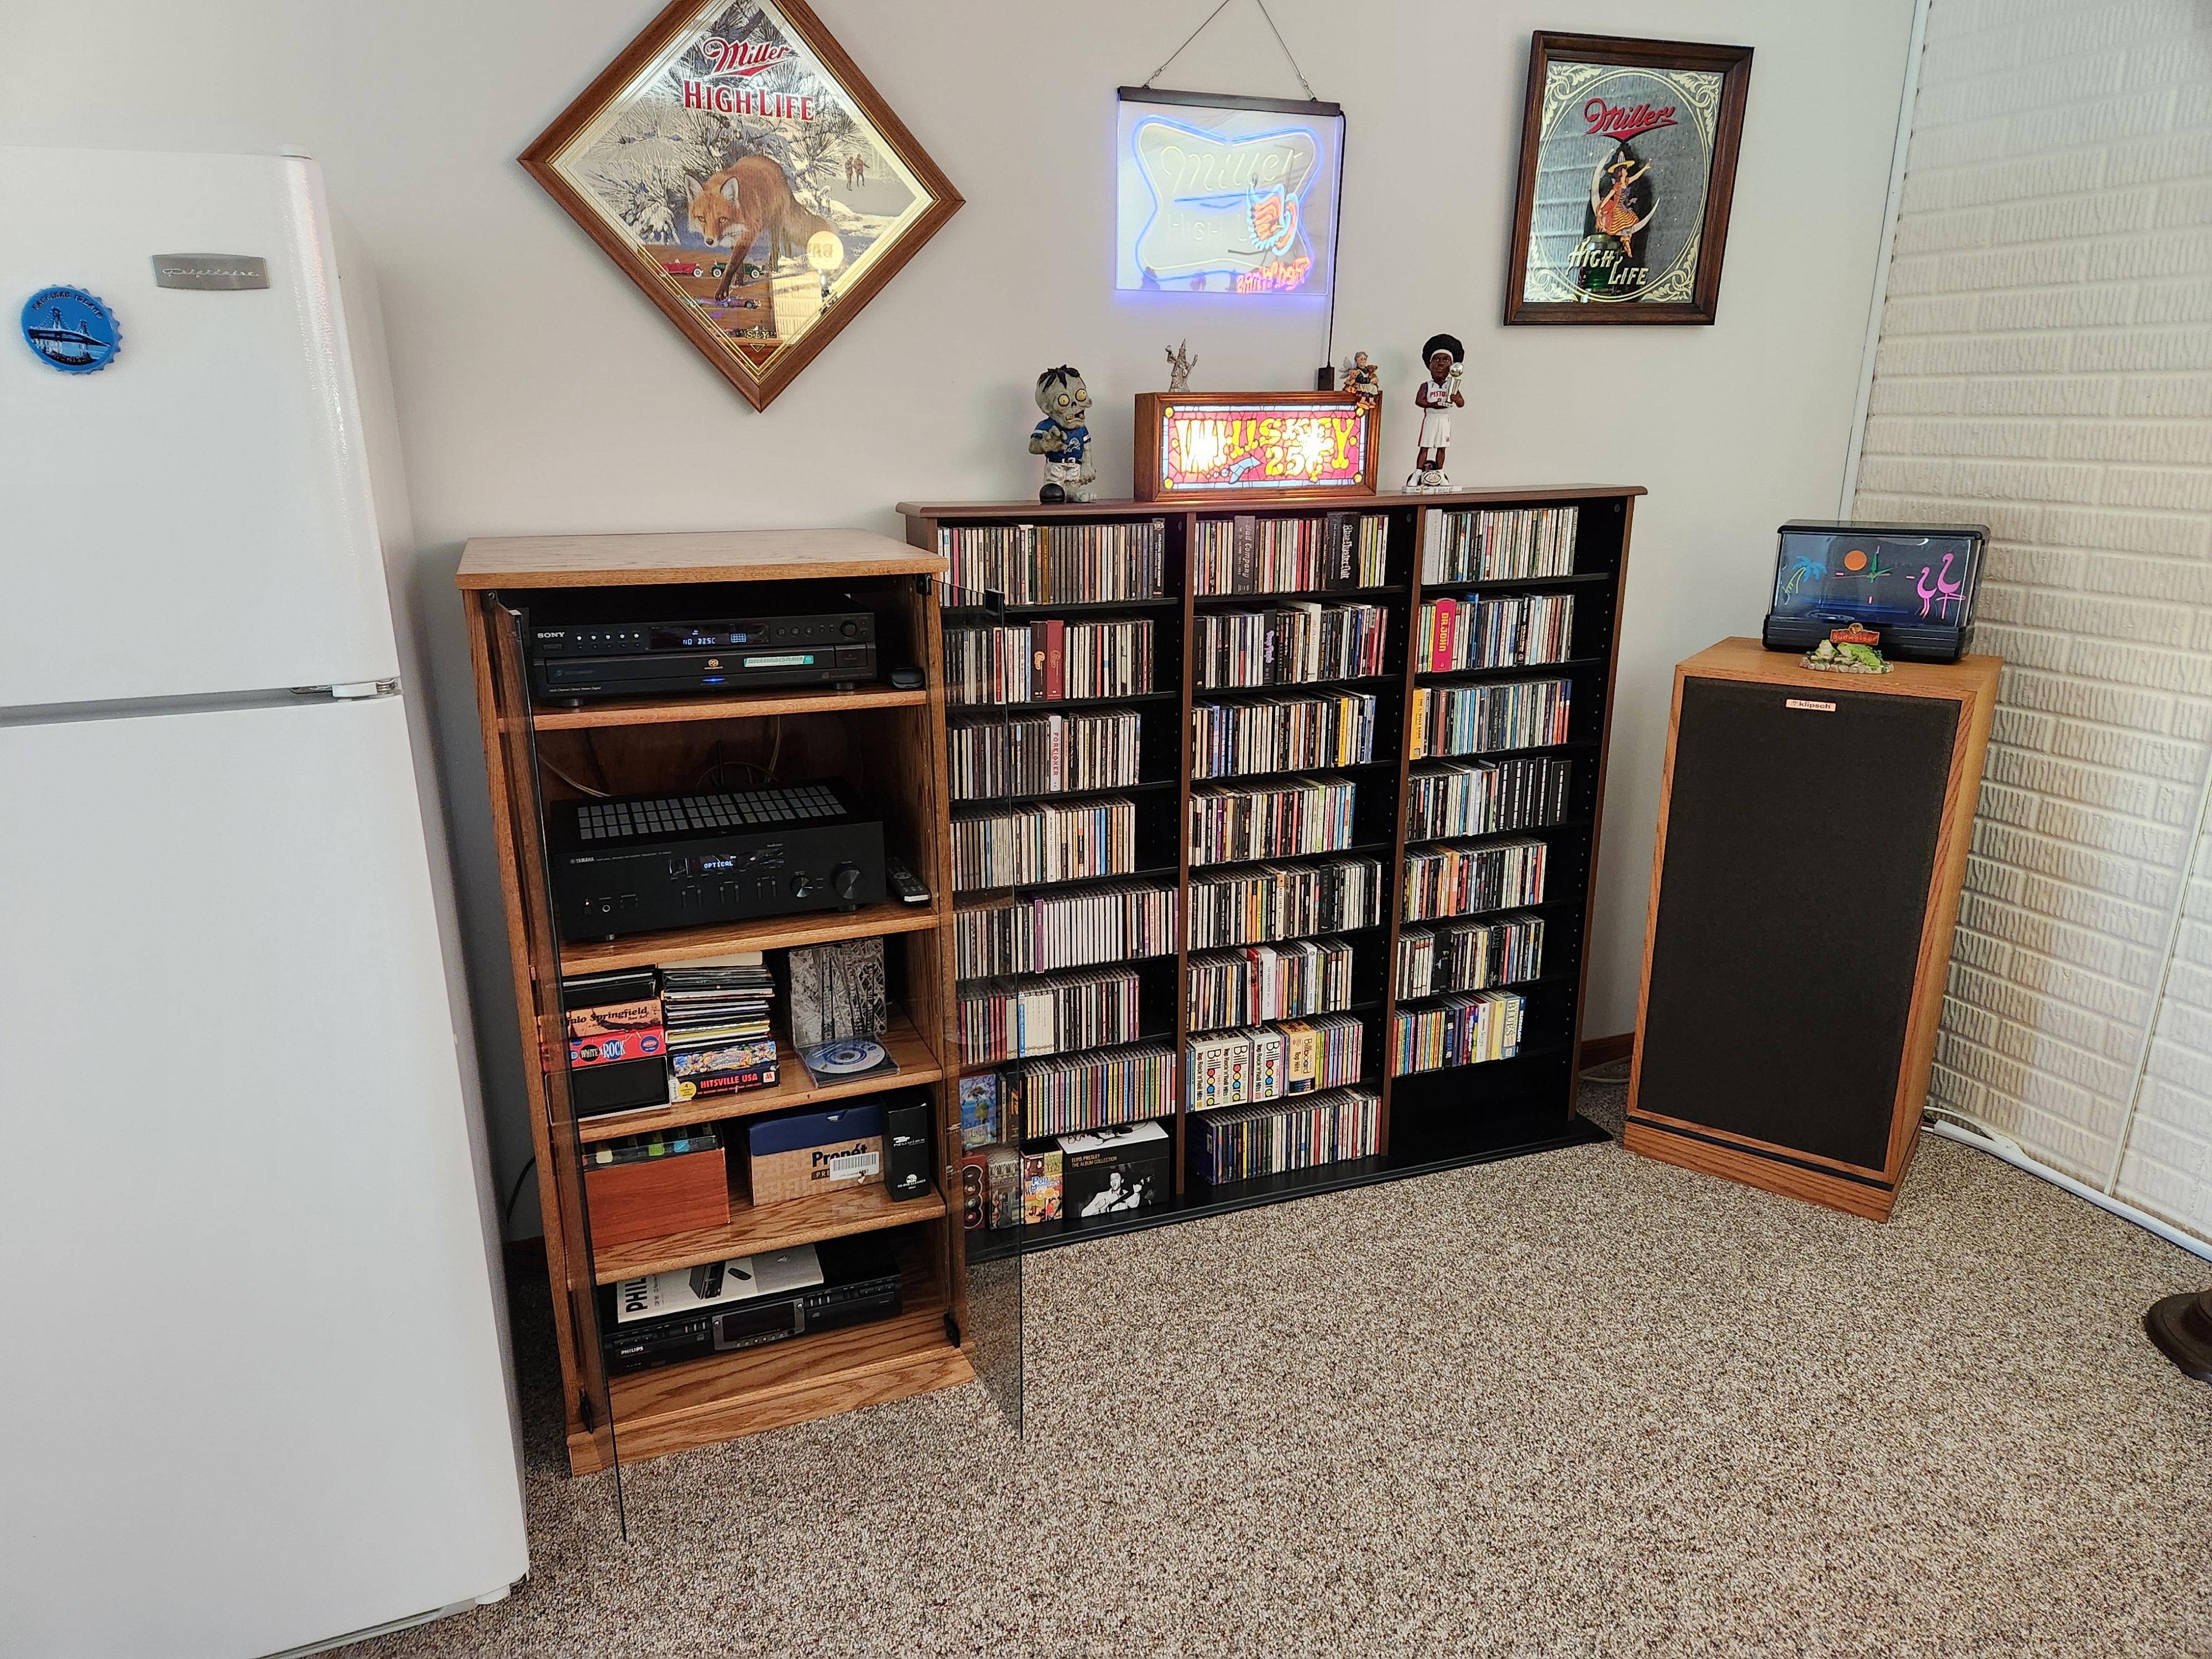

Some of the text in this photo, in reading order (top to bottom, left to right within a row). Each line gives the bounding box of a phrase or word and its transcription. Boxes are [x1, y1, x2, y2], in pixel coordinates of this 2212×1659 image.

[702, 38, 792, 76] Miller
[684, 80, 815, 122] HIGH LIFE
[1584, 97, 1676, 134] Miller
[1161, 145, 1303, 192] Miller
[161, 268, 260, 279] Frigidaire
[1567, 237, 1650, 285] HIGH LIFE
[1175, 416, 1357, 473] WHISKEY
[1241, 525, 1253, 578] Bad Company
[1831, 633, 1879, 644] Budweiser
[1798, 701, 1832, 710] klipsch
[703, 860, 734, 869] OPTICAL
[1492, 928, 1502, 948] WAR
[589, 1006, 648, 1022] Springfield
[1505, 1002, 1516, 1037] BLUES
[580, 1048, 599, 1059] WHITE
[602, 1040, 626, 1059] ROCK
[1293, 1051, 1301, 1061] Top
[1303, 1038, 1313, 1074] Billboard
[700, 1073, 758, 1089] HITSVILLE USA
[1206, 1048, 1222, 1107] Billboard
[1232, 1045, 1248, 1102] Billboard
[1265, 1040, 1280, 1098] Billboard
[1094, 1156, 1117, 1165] COLLECTION
[1030, 1180, 1060, 1192] Memories
[1031, 1176, 1049, 1186] Pop
[625, 1277, 648, 1313] PHIL
[620, 1345, 644, 1355] PHILIPS
